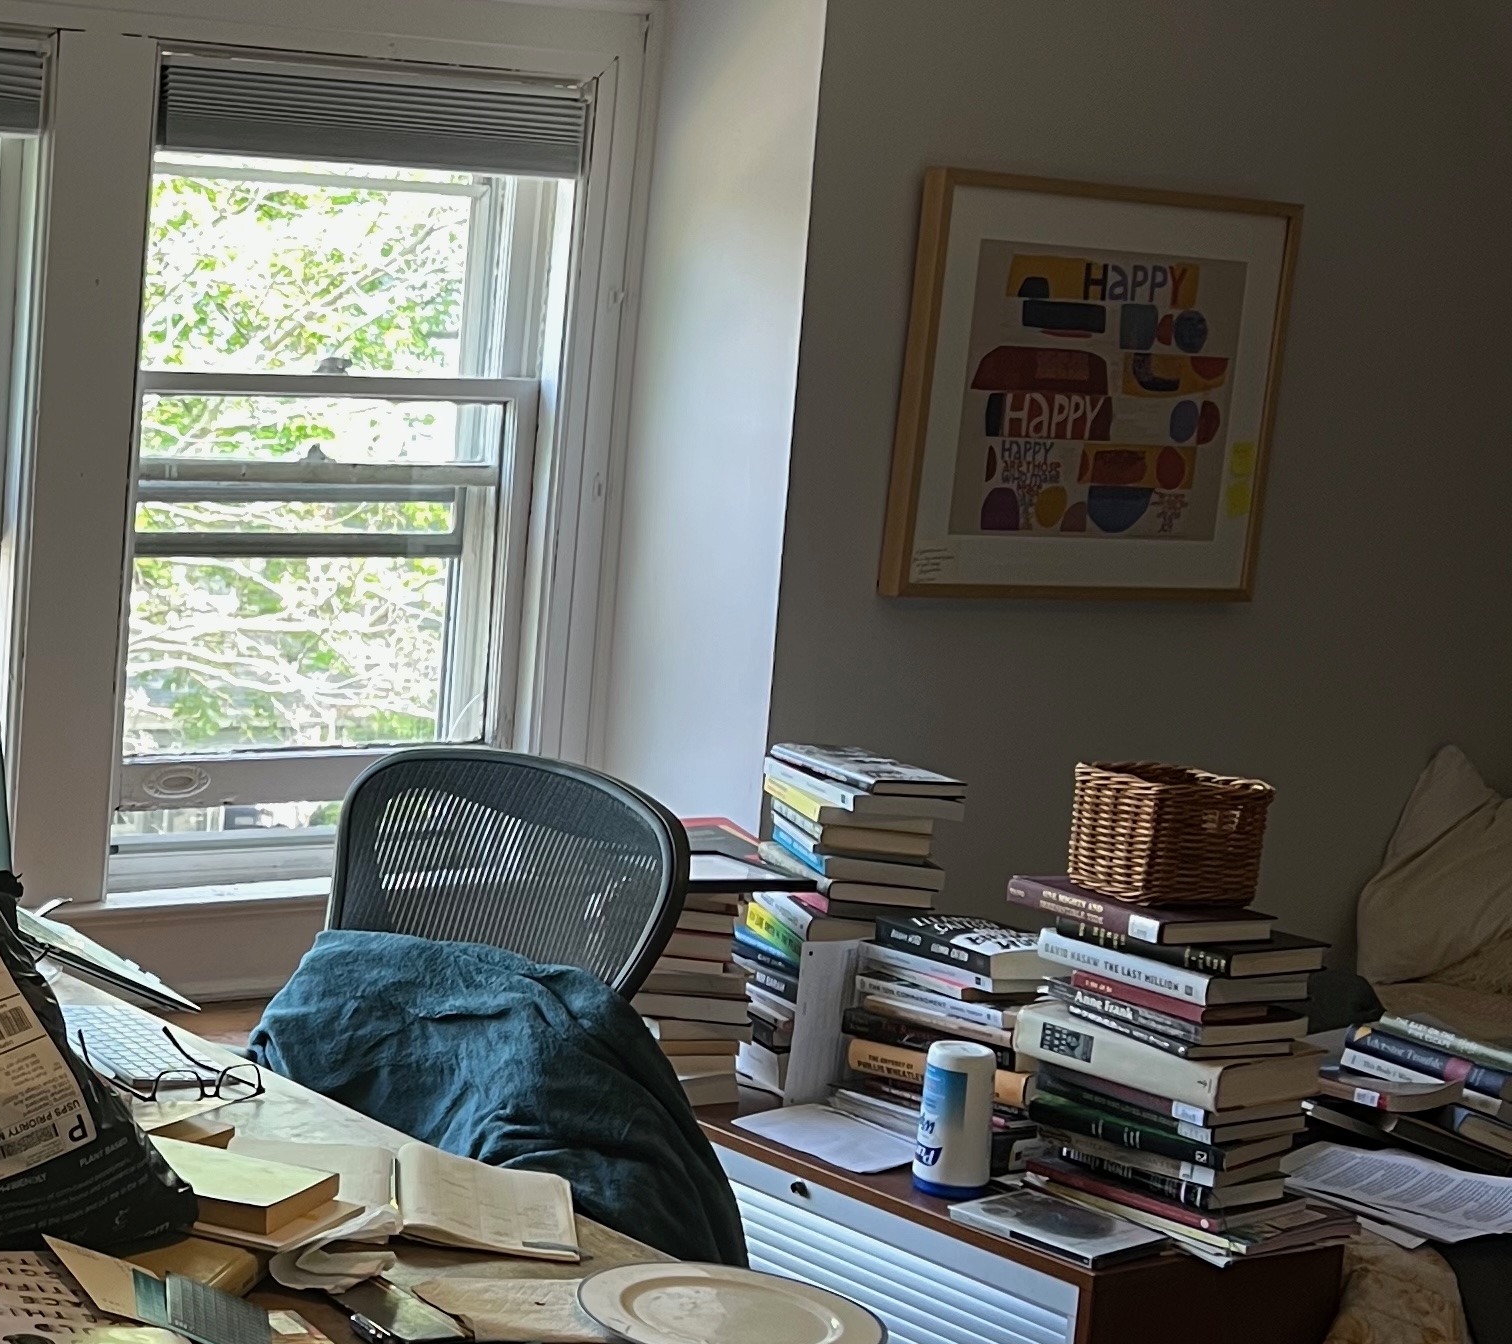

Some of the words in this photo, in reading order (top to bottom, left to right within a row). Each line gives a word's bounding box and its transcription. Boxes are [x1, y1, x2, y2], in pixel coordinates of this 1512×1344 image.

[1044, 942, 1069, 959] DAVID
[1104, 960, 1119, 974] THE
[1121, 965, 1143, 980] LAST
[1144, 972, 1180, 992] MILLION
[1074, 991, 1103, 1011] Anne
[1104, 1000, 1134, 1021] Frank
[886, 1066, 921, 1081] WHEATLE
[55, 1099, 81, 1117] USPS
[8, 1112, 53, 1137] PRIORITY
[68, 1114, 88, 1142] P
[79, 1149, 104, 1167] PLANT
